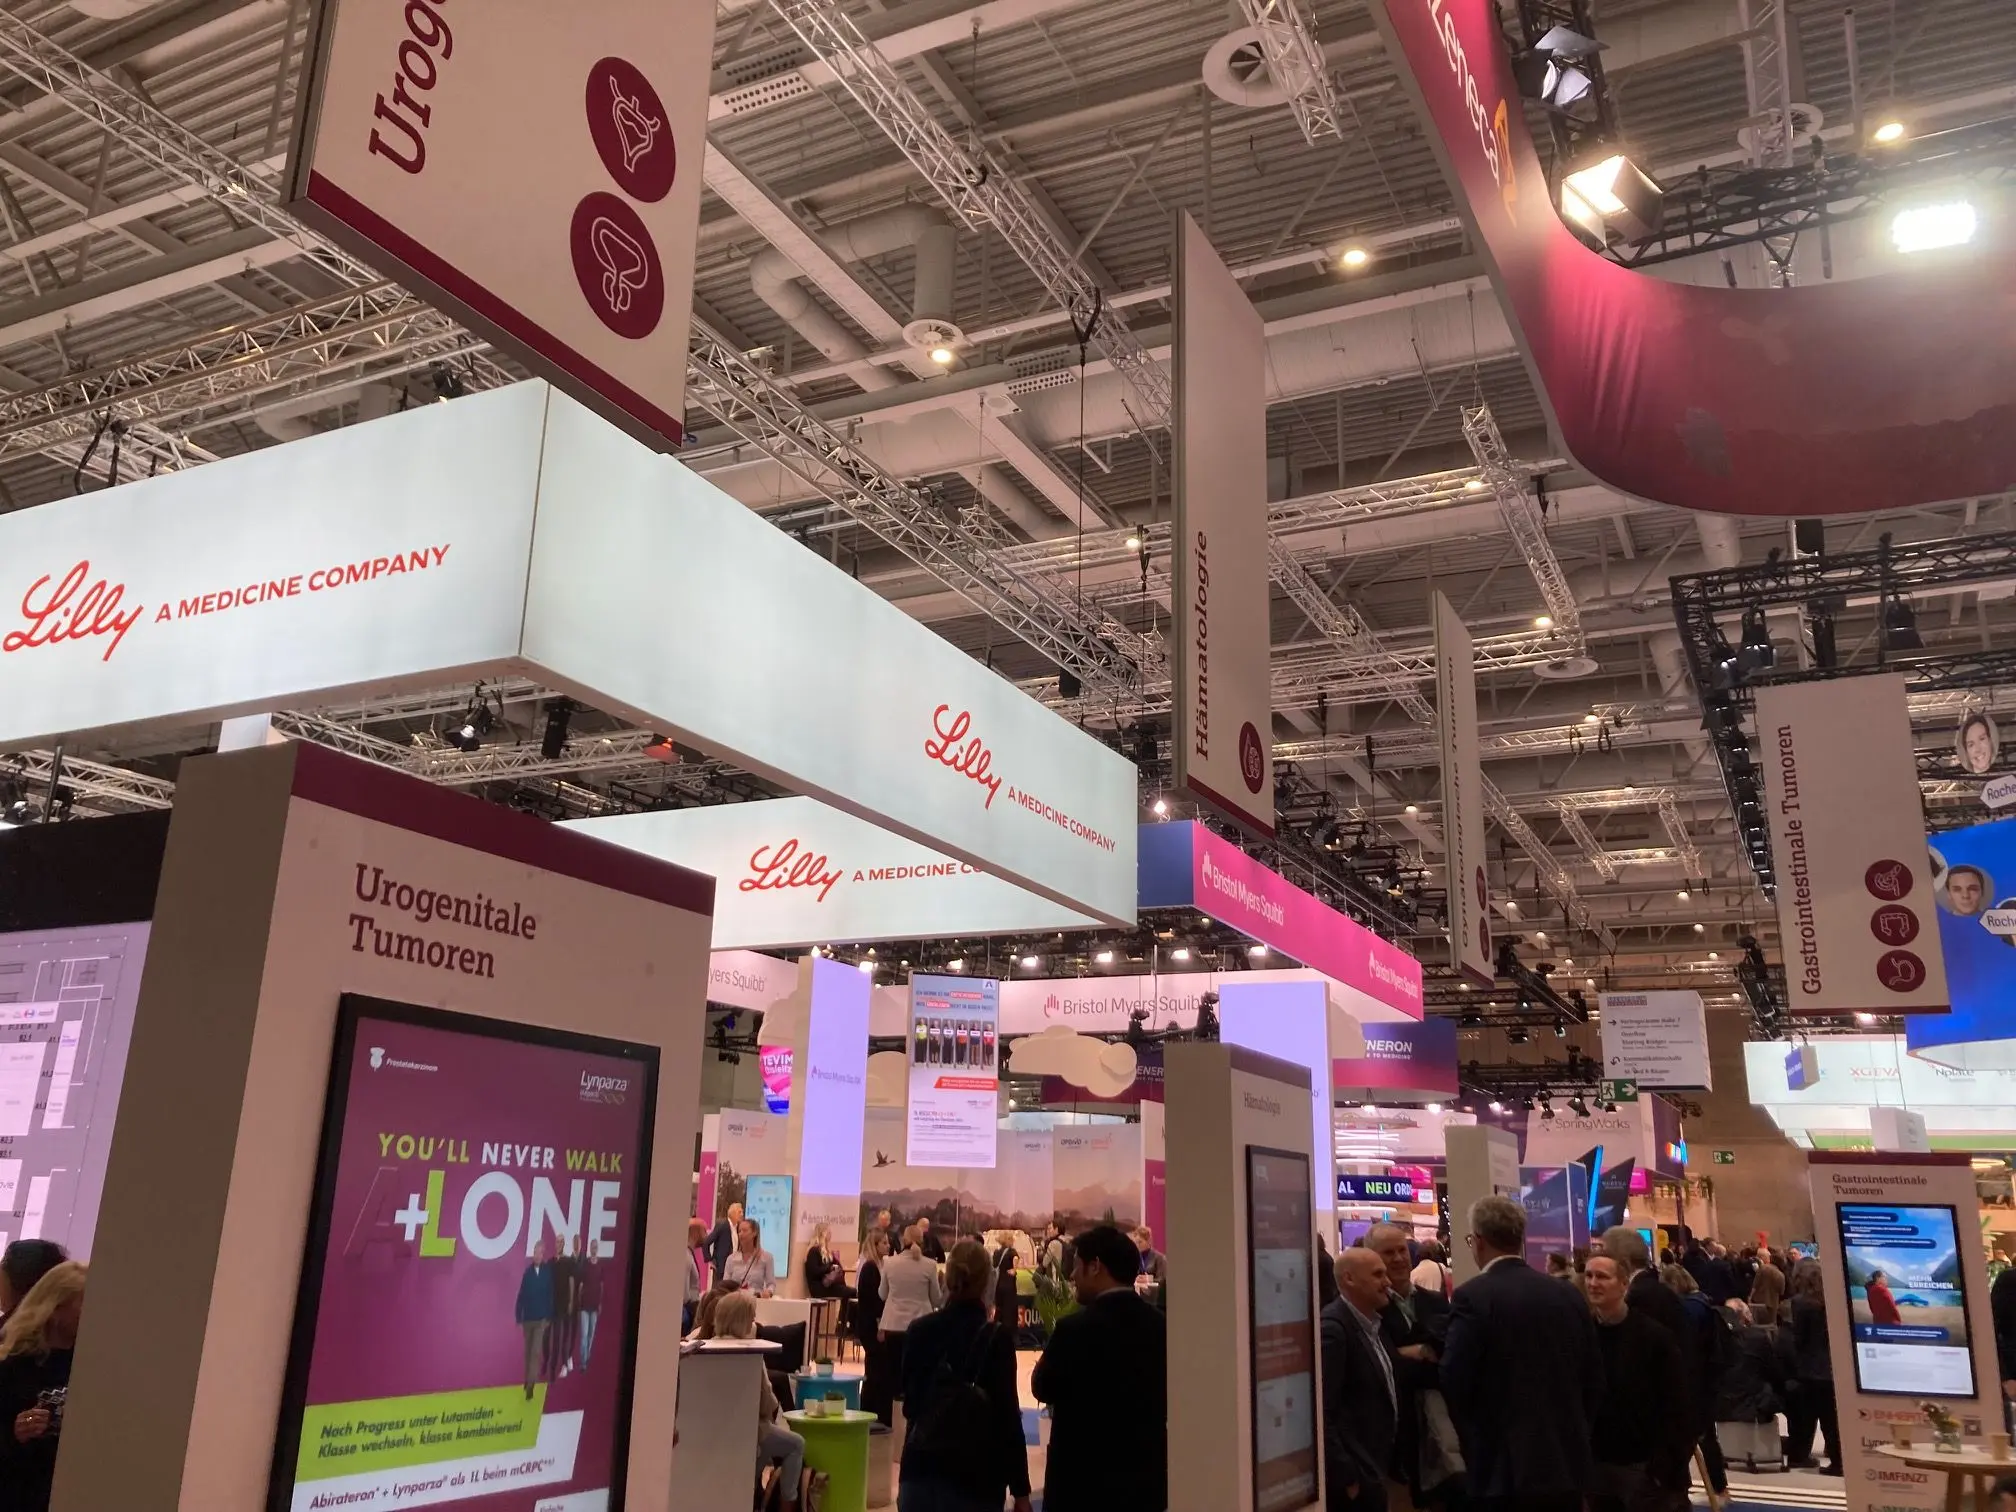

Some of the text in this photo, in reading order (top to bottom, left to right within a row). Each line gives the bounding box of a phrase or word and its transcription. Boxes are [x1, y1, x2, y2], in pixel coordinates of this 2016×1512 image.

[368, 0, 453, 174] Urog
[2, 543, 451, 662] Lilly A MEDICINE COMPANY
[1195, 530, 1209, 762] Hämatologie
[924, 704, 1116, 853] Lilly A MEDICINE COMPANY
[738, 838, 844, 903] Lilly
[853, 870, 865, 883] A
[869, 862, 957, 881] MEDICINE
[1777, 724, 1822, 995] Gastrointestinale Tumoren
[356, 863, 537, 940] Urogenitale
[1213, 865, 1284, 926] Bristol Myers Squibb
[1987, 915, 2016, 928] Roch
[349, 913, 495, 979] Tumoren
[1063, 998, 1107, 1014] Bristol
[1112, 997, 1156, 1014] Myers
[1365, 1040, 1413, 1053] NERON
[1555, 1119, 1630, 1130] SpringWorks
[481, 1142, 555, 1170] NEVER
[565, 1149, 623, 1174] WALK
[1365, 1181, 1392, 1194] NEU
[1832, 1173, 1928, 1186] Gastrointestinale
[1833, 1185, 1884, 1196] Tumoren
[320, 1420, 353, 1439] Nach
[355, 1418, 406, 1436] Progress
[408, 1415, 438, 1428] unter
[440, 1407, 494, 1425] Lutamiden
[317, 1442, 358, 1459] Klasse
[420, 1429, 453, 1445] klasse
[450, 1472, 466, 1487] als
[482, 1468, 507, 1482] beim
